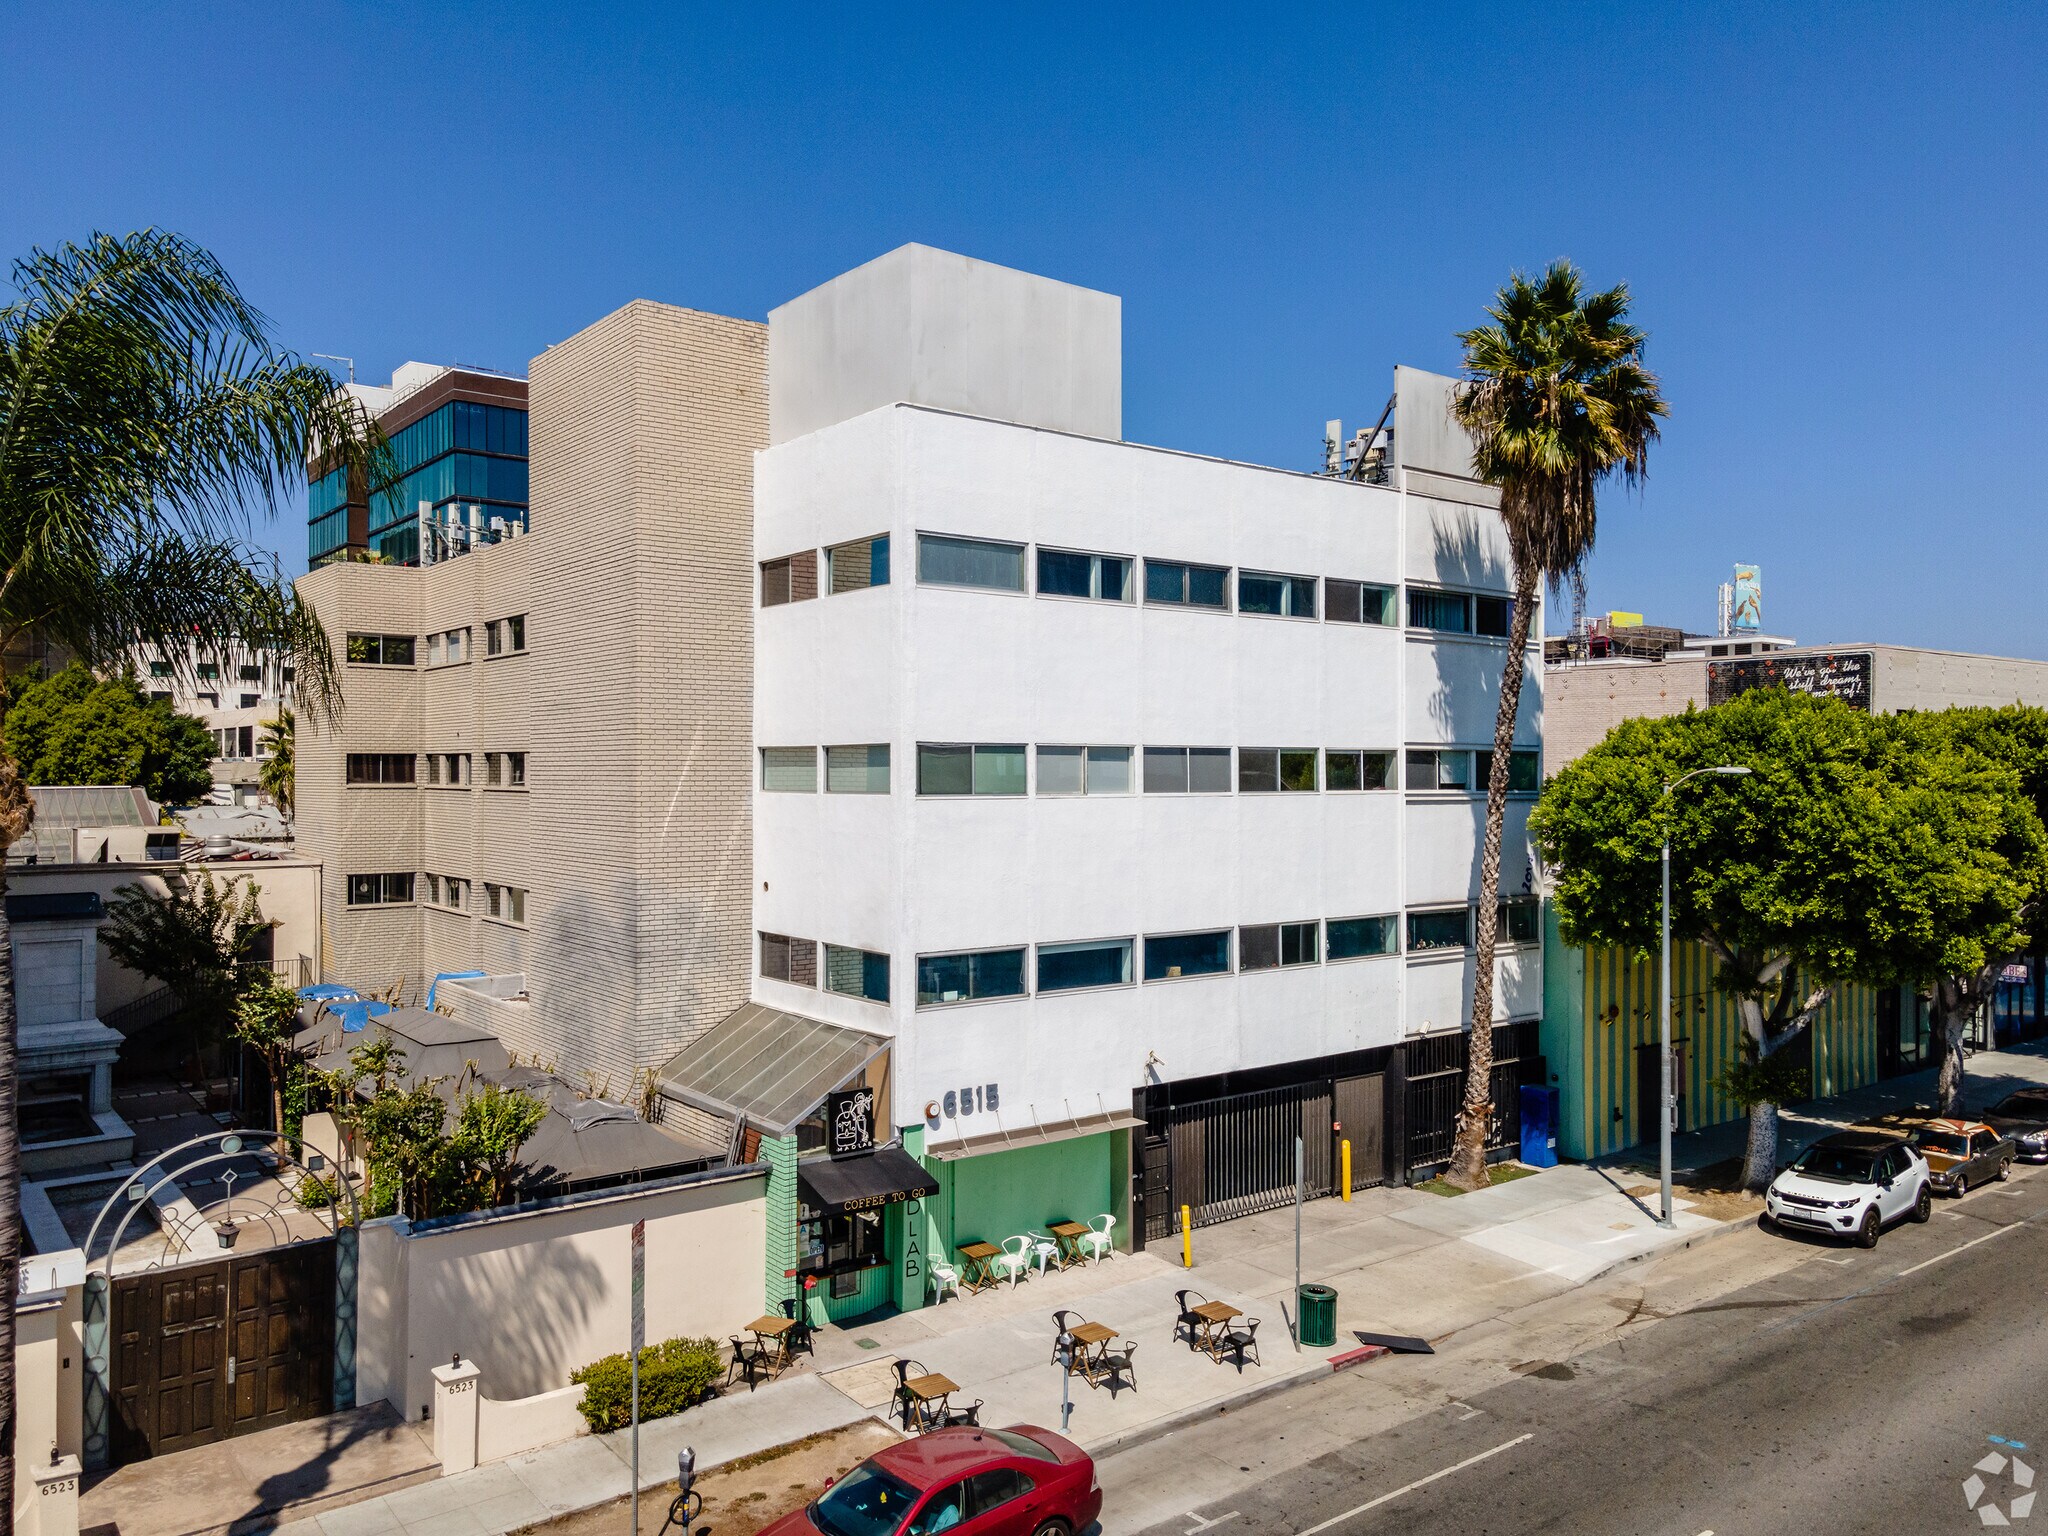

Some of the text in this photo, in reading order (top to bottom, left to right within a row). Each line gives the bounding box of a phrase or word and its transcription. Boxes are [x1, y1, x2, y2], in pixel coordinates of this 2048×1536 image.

[1784, 666, 1815, 679] We've
[1842, 660, 1861, 672] the
[1788, 674, 1861, 692] stuff dreams
[1843, 682, 1862, 699] of!
[943, 1084, 999, 1119] 6515
[844, 1187, 926, 1211] COFFEE TO GO
[800, 1225, 807, 1233] A
[906, 1199, 921, 1278] DLAB
[449, 1381, 473, 1395] 6523
[42, 1480, 75, 1496] 6523
